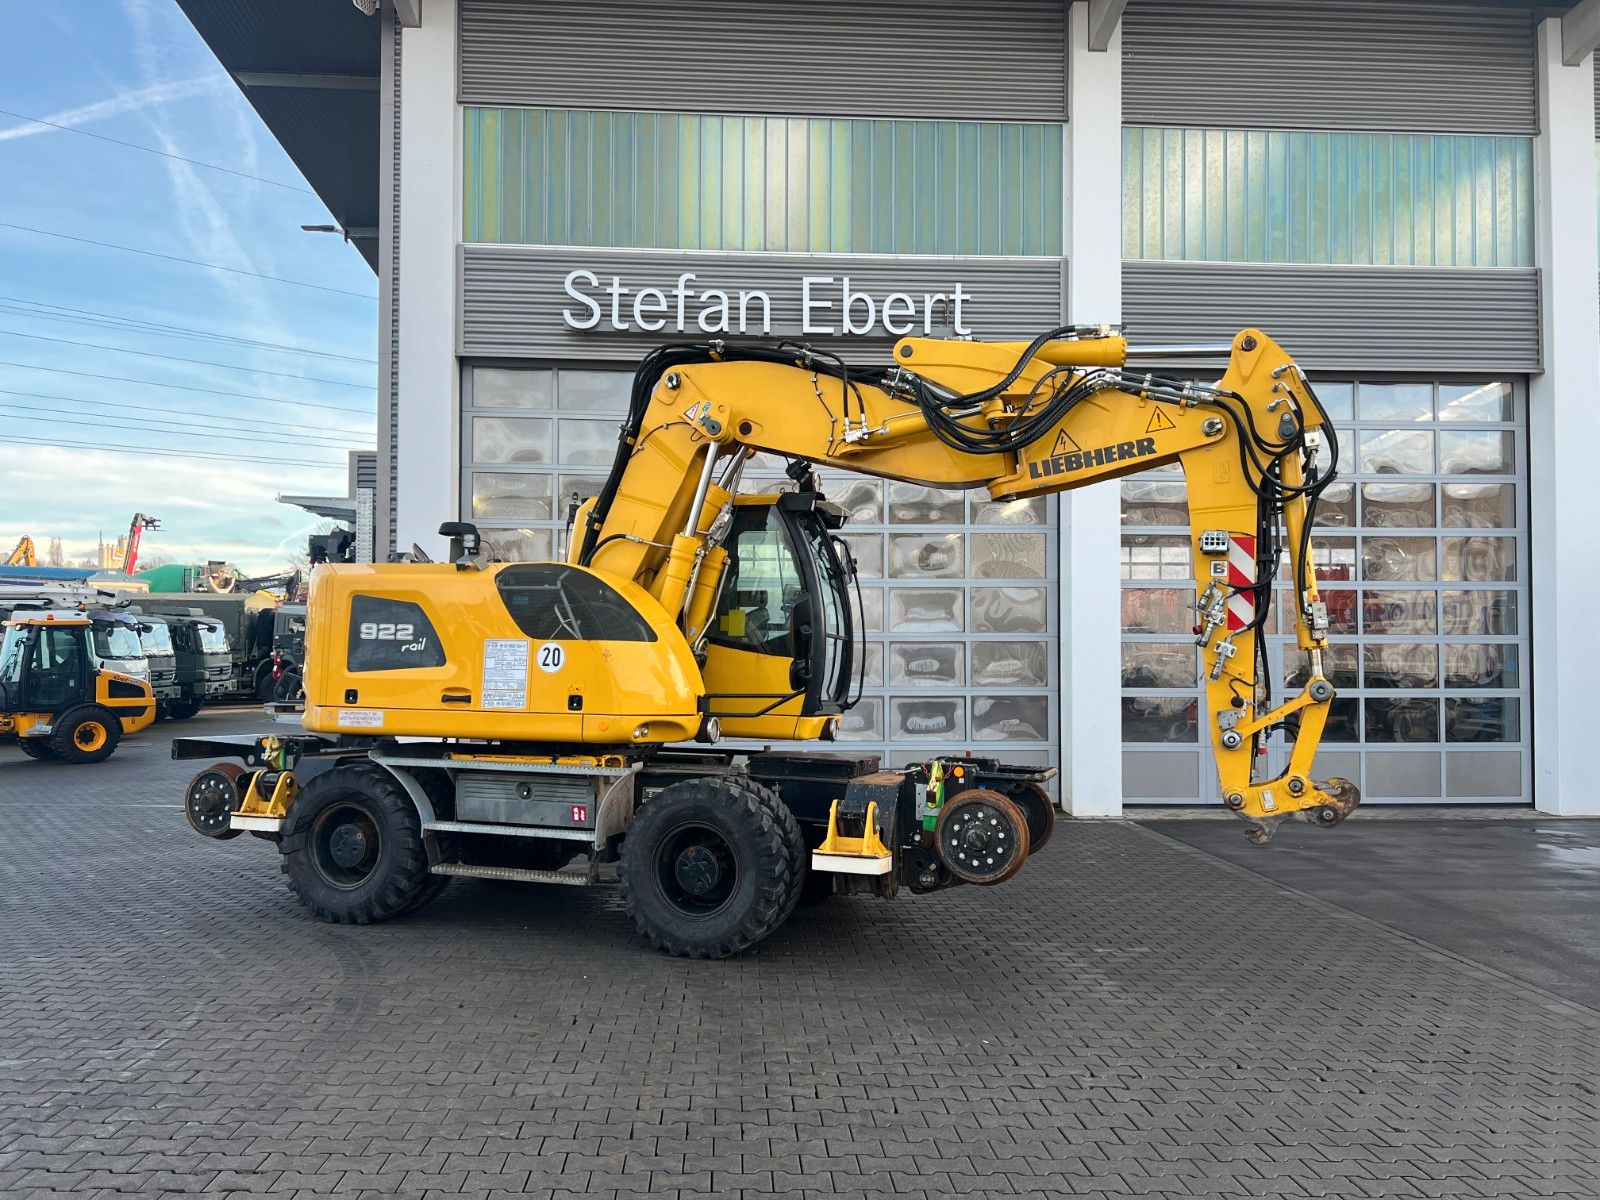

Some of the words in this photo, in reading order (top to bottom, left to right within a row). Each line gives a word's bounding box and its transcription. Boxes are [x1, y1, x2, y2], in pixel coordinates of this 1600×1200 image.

[562, 269, 771, 335] Stefan
[802, 275, 972, 337] Ebert
[1028, 437, 1157, 480] LIEBHERR
[360, 622, 415, 641] 922
[401, 637, 427, 652] rail
[542, 642, 561, 662] 20
